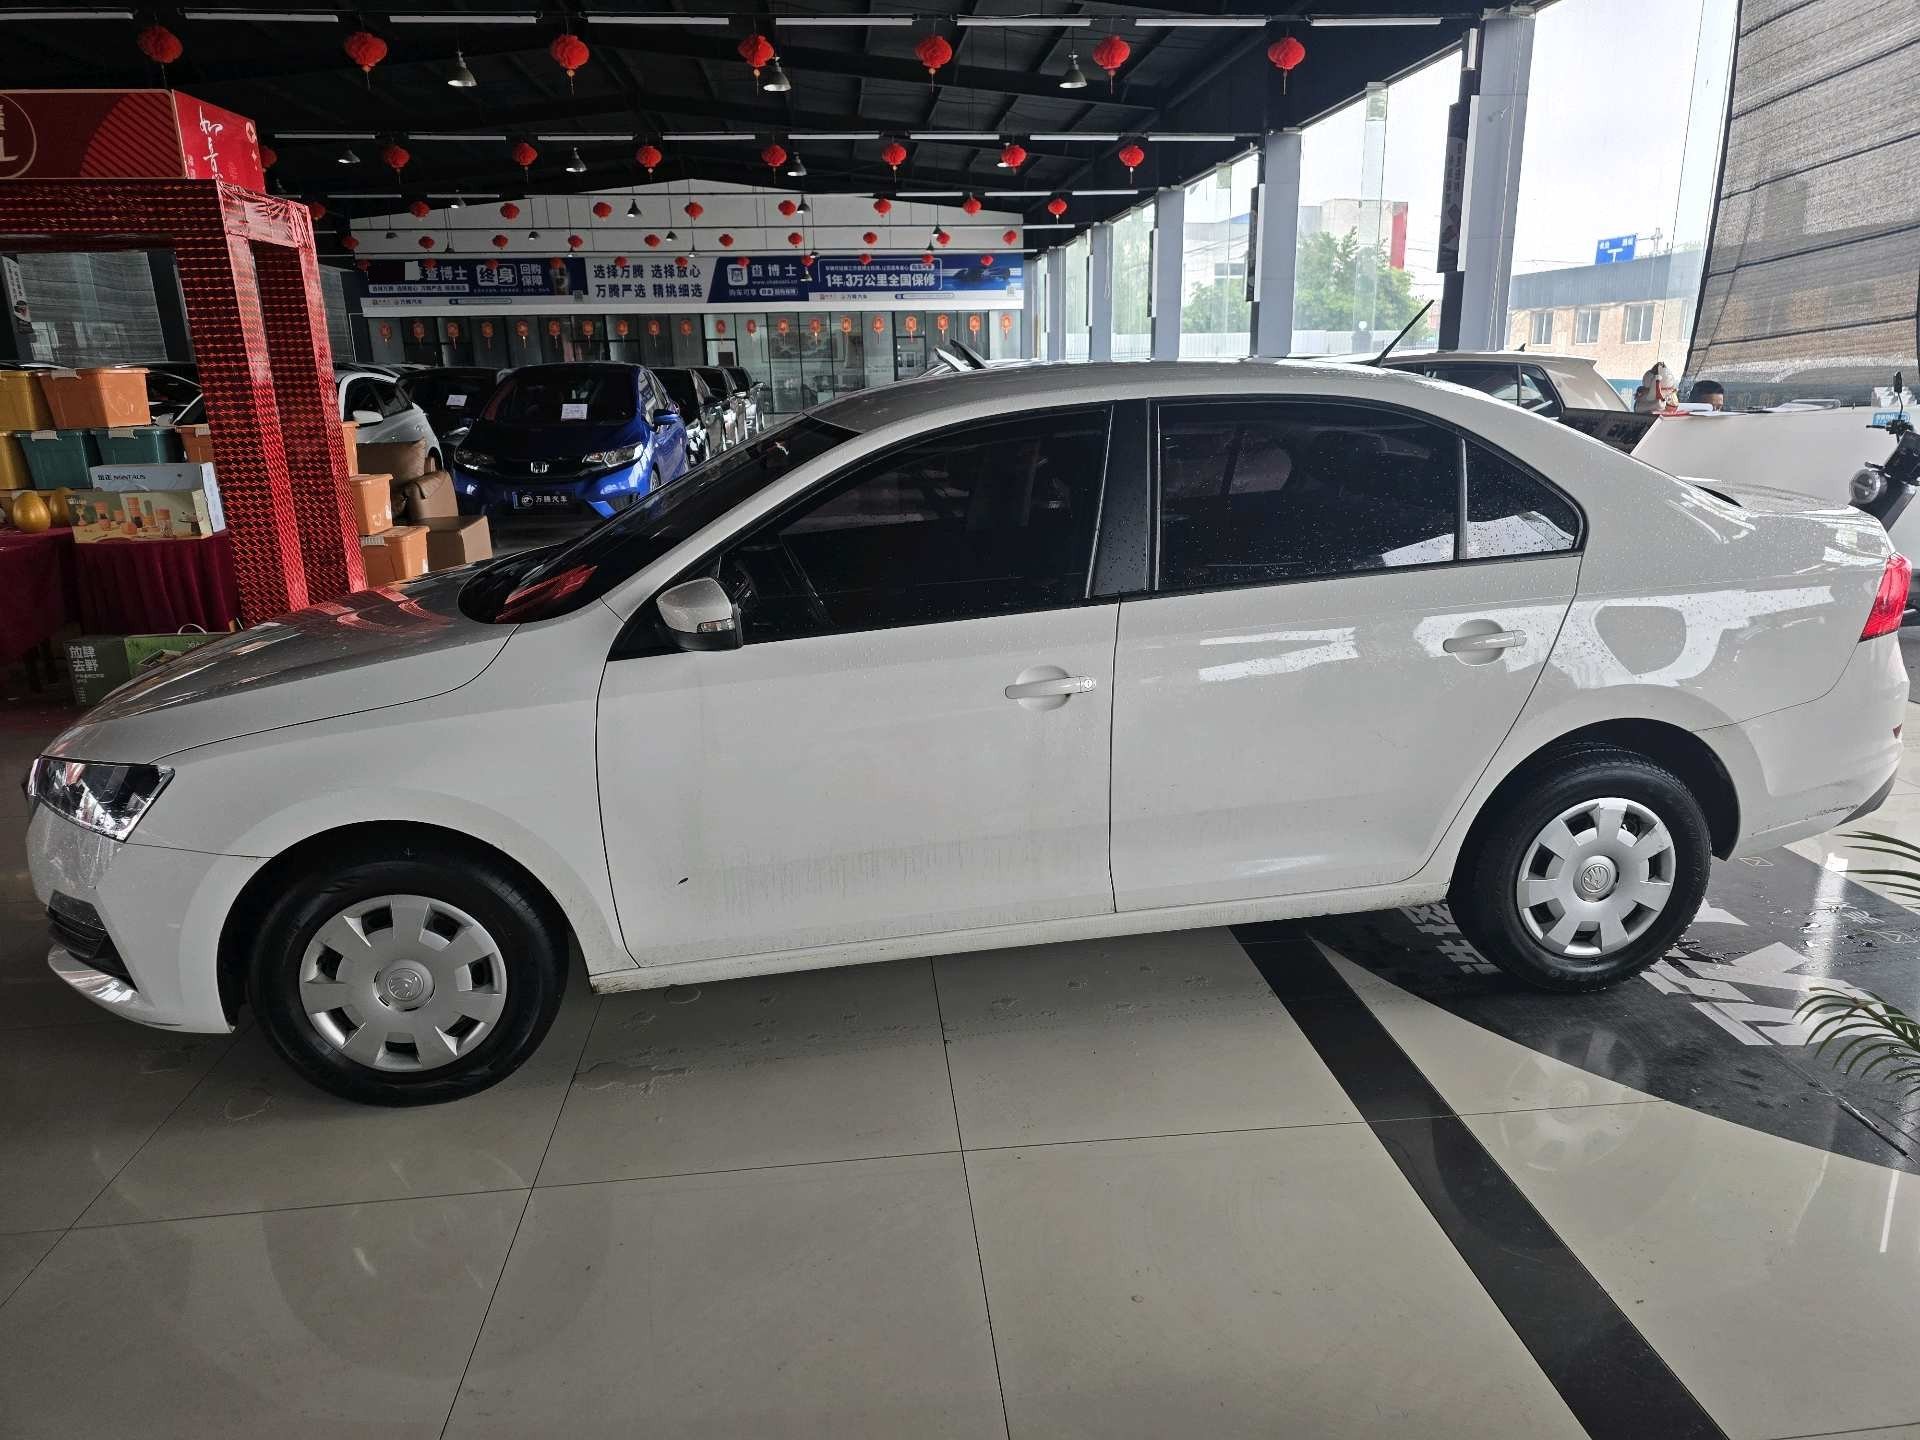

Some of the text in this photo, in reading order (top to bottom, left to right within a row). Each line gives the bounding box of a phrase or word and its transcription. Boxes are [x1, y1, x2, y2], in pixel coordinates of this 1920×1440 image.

[593, 264, 702, 279] 选择万腾 选择放心
[751, 263, 798, 277] 查博士
[595, 283, 703, 298] 万腾严选 精挑细选
